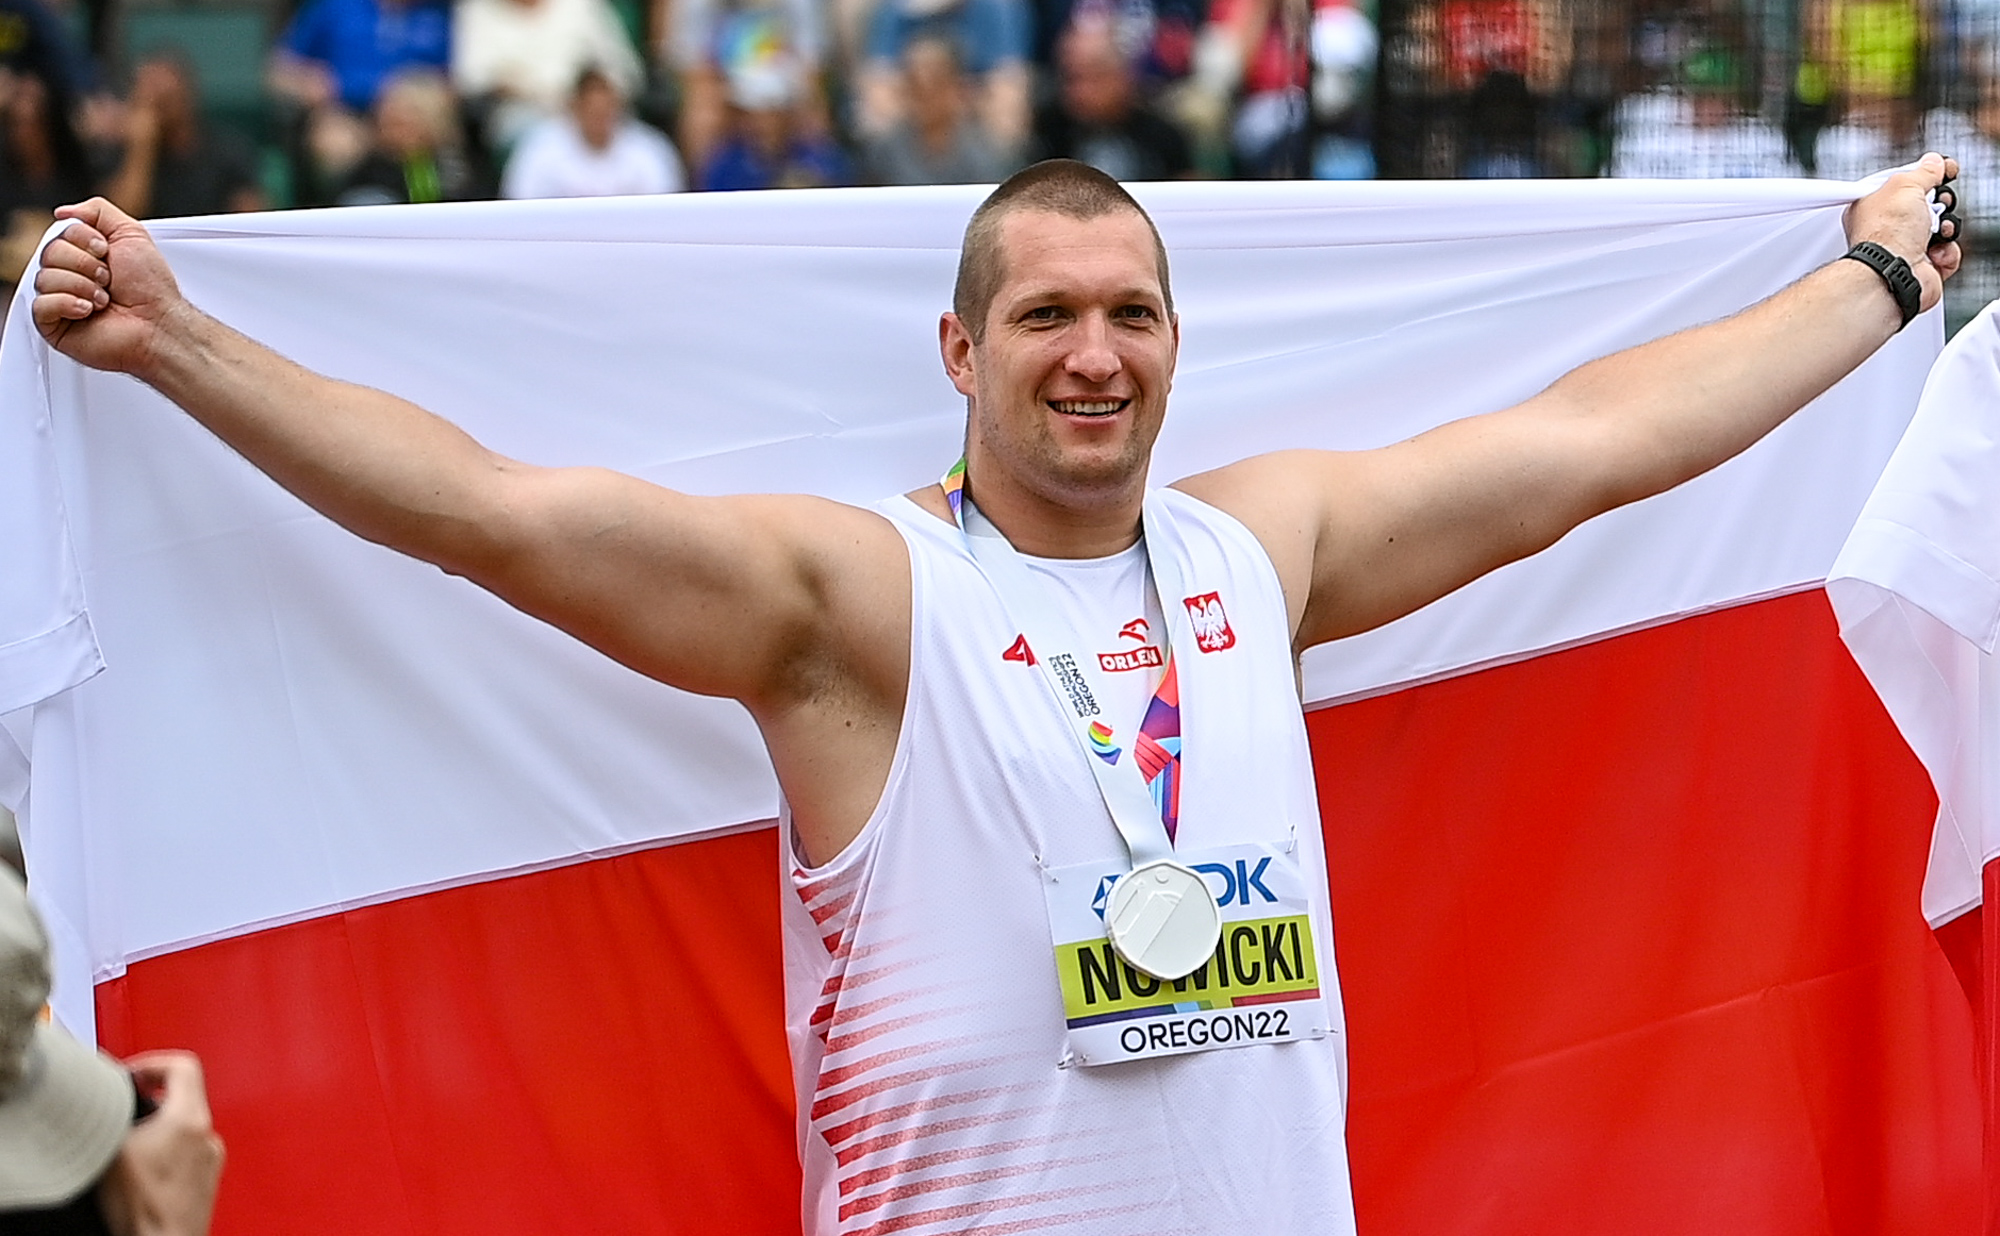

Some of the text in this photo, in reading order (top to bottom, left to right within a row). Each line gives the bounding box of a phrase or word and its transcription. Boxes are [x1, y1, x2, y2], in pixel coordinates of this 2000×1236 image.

[1101, 648, 1160, 670] ORLEN
[1061, 653, 1101, 715] OREGON 22
[1186, 857, 1279, 907] DK
[1121, 1010, 1290, 1052] OREGON22
